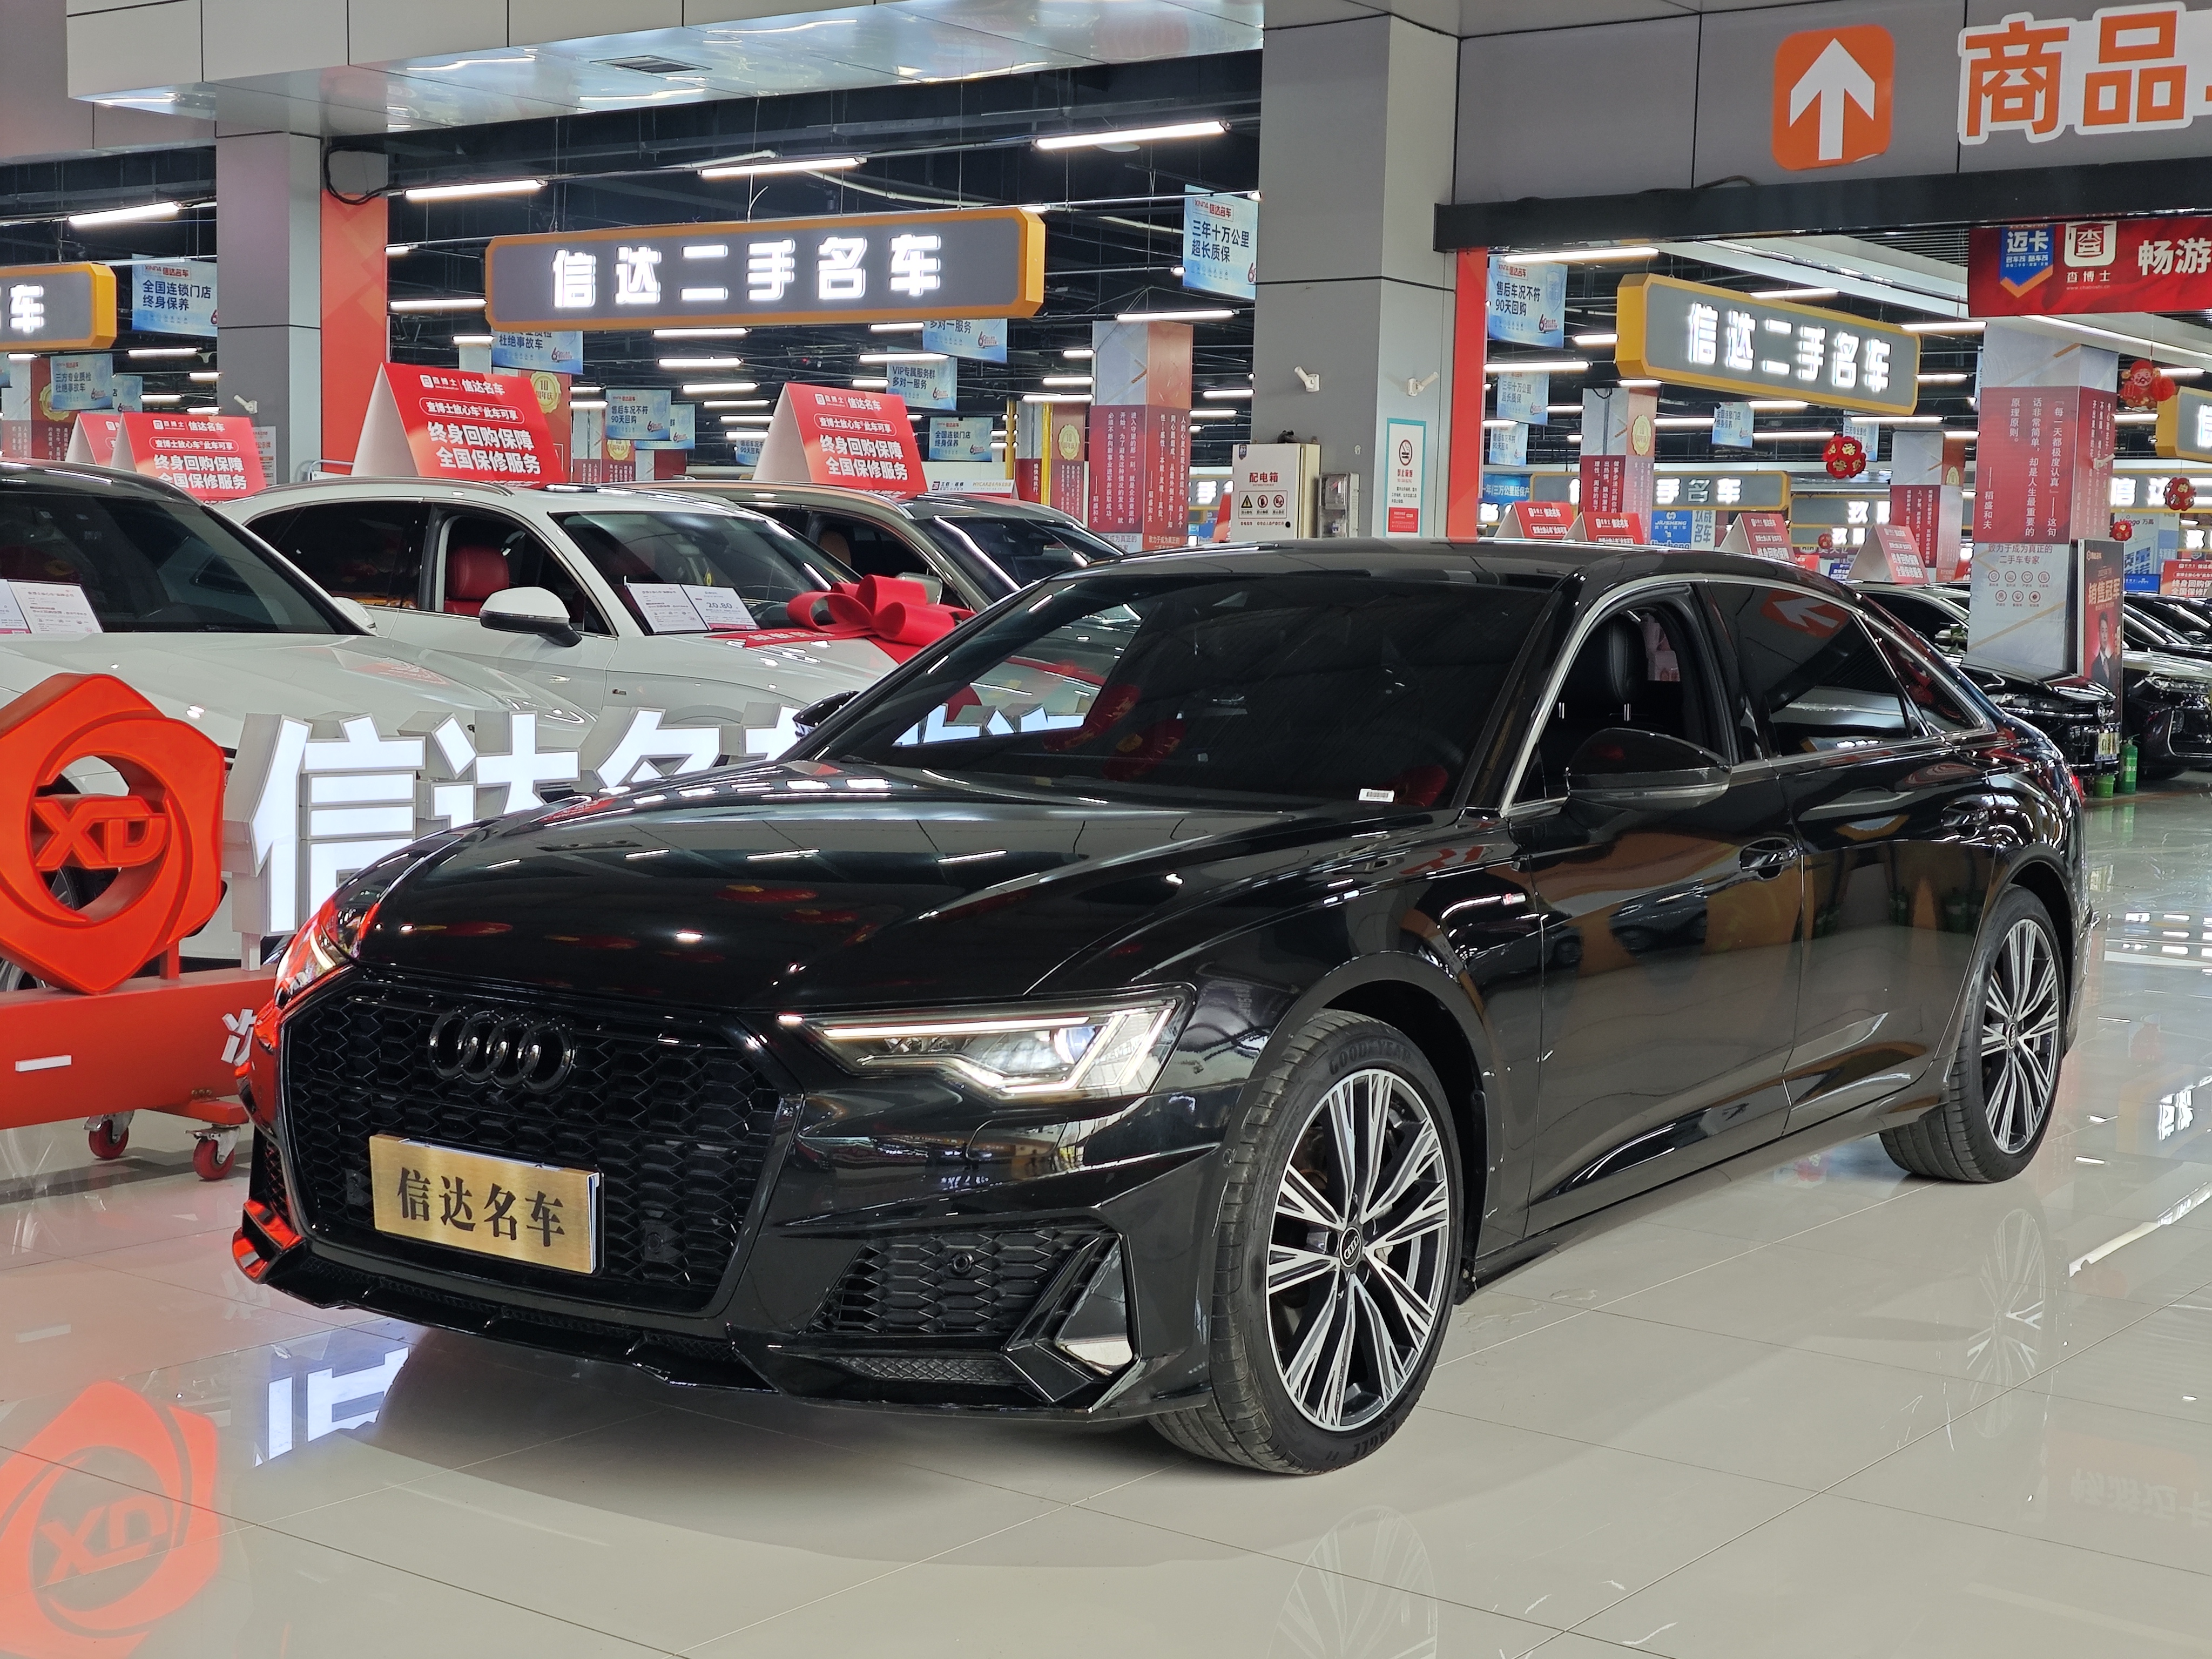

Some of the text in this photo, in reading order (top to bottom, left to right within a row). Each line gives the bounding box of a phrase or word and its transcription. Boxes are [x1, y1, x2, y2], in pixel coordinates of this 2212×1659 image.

[1965, 10, 2212, 137] 商品
[1210, 204, 1232, 218] 信达名车
[1192, 220, 1249, 248] 三年十万公里
[2007, 230, 2049, 253] 迈卡
[1191, 239, 1230, 263] 超长质保
[2137, 237, 2212, 275] 畅游
[163, 266, 189, 277] 信达名车
[552, 233, 941, 308] 信达二手名车
[1509, 266, 1526, 278] 信达名车
[2066, 270, 2110, 283] 查博士
[142, 280, 212, 299] 全国连锁门店
[1496, 280, 1541, 302] 售后车况不符
[9, 284, 45, 334] 车
[142, 294, 190, 311] 终身保养
[1495, 299, 1527, 316] 90天回购
[499, 334, 543, 350] 杜绝事故车
[1688, 302, 1891, 392] 信达二手名车
[892, 366, 935, 379] VIP专属服务群
[461, 379, 505, 396] 信达名车
[892, 377, 927, 389] 多对一服务
[1501, 381, 1532, 394] 三年十万公里
[611, 406, 649, 415] 售后车况不符
[847, 397, 882, 411] 信达名车
[188, 421, 226, 432] 信达名车
[611, 415, 637, 424] 90天回购
[2009, 398, 2020, 442] 原理原则。
[427, 420, 535, 451] 终身回购保障
[934, 439, 959, 447] 终身保养
[935, 431, 971, 439] 全国连锁门店
[819, 434, 904, 460] 终身回购保障
[153, 454, 245, 473] 终身回购保障
[436, 446, 541, 475] 全国保修服务
[826, 456, 908, 481] 全国保修服务
[158, 473, 247, 490] 全国保修服务
[1249, 471, 1279, 483] 配电箱
[1988, 544, 2053, 554] 致力于成为真正的
[1999, 555, 2040, 564] 二手车专家
[2088, 578, 2120, 605] 销售冠军
[32, 795, 168, 869] XD
[397, 1166, 565, 1247] 信达名车
